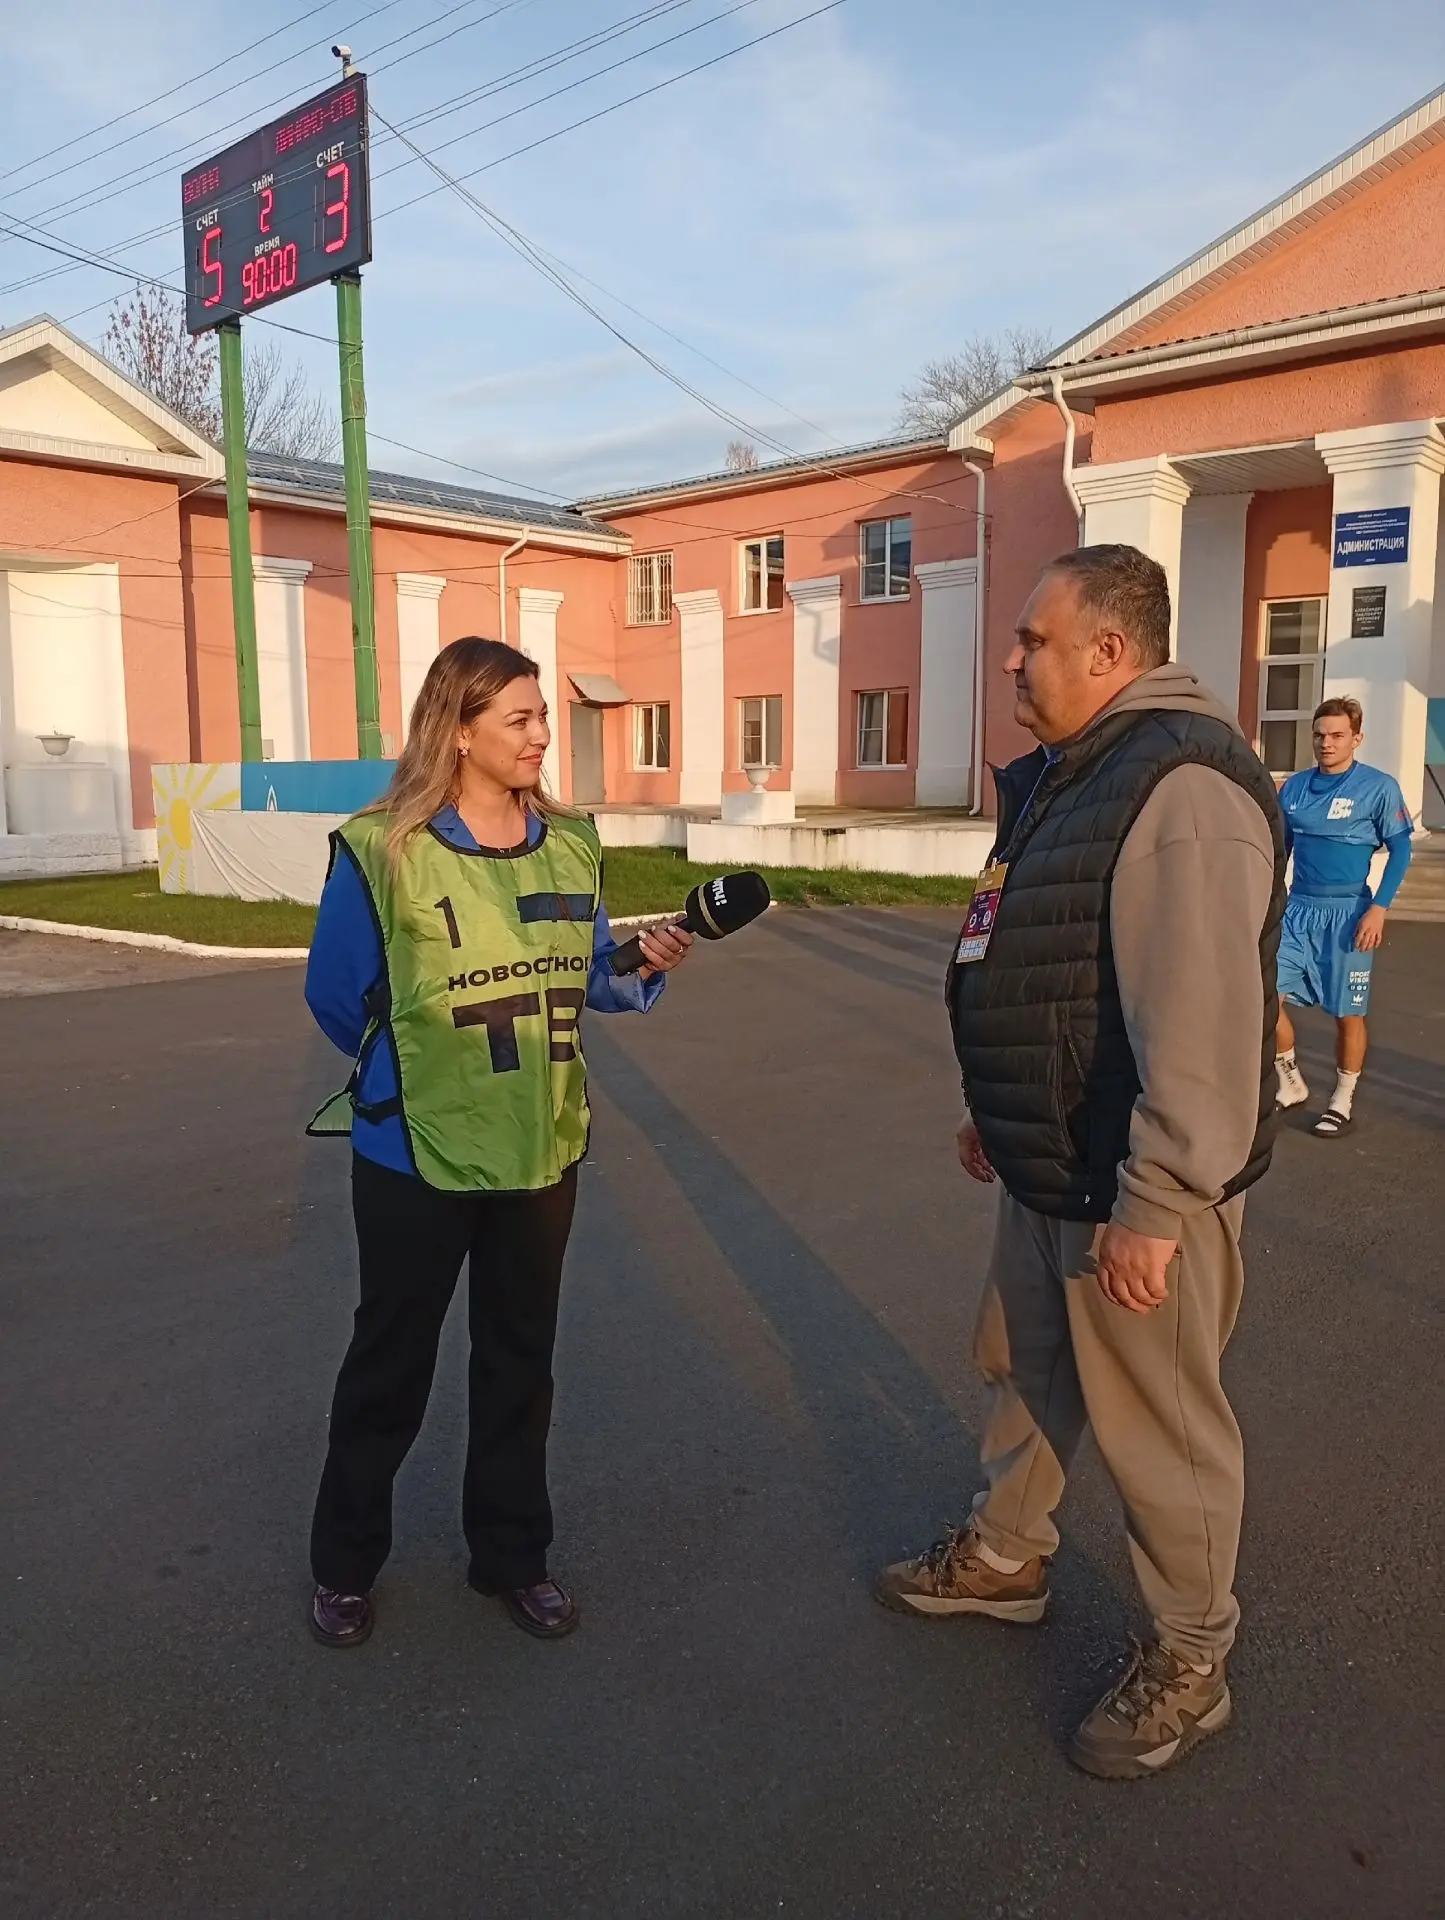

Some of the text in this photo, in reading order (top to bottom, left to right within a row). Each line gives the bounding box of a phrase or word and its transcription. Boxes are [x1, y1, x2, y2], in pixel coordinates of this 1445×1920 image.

[316, 141, 345, 168] СЧЕТ
[252, 174, 274, 194] ТАЙМ
[196, 209, 219, 231] СЧЕТ
[259, 188, 273, 232] 2
[326, 162, 349, 253] 3
[254, 236, 281, 257] ВРЕМЯ
[203, 227, 222, 307] 5
[242, 243, 297, 304] 90:00
[1336, 536, 1405, 556] АДМИНИСТРАЦИЯ
[434, 896, 462, 949] 1
